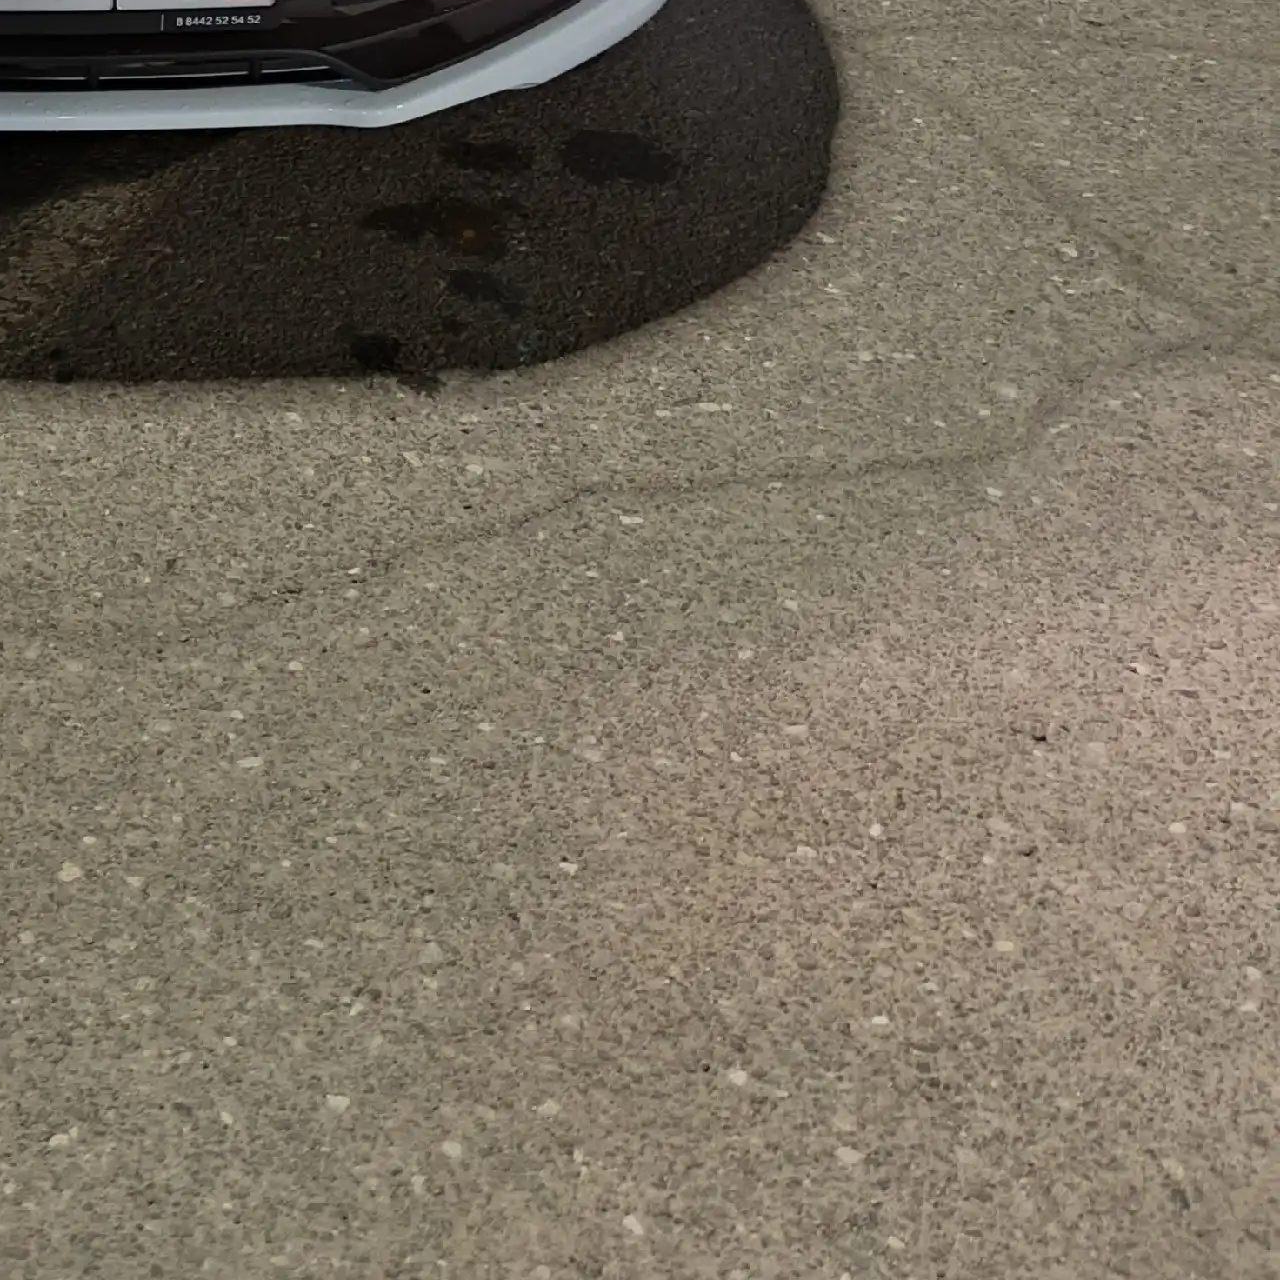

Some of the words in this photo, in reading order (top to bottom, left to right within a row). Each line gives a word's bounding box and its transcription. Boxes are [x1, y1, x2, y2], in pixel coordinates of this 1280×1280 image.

[185, 16, 213, 27] 8442
[215, 16, 229, 25] 52
[247, 14, 261, 24] 52
